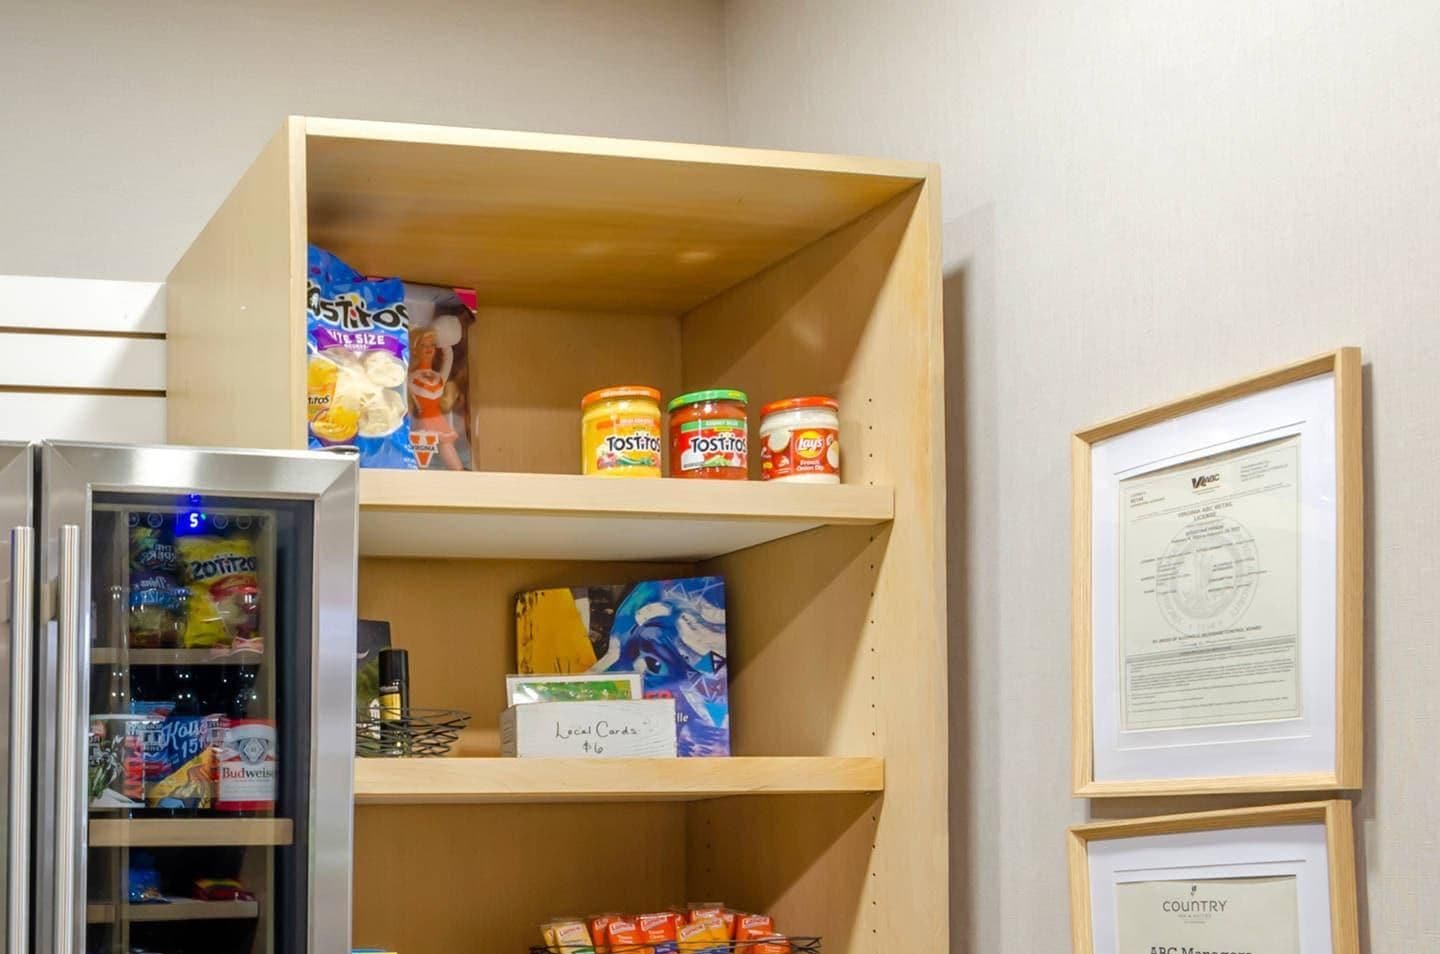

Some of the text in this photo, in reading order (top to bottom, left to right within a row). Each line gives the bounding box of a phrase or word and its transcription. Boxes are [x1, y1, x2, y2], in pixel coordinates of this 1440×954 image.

[355, 332, 386, 345] SIZE
[555, 719, 639, 740] Local Cards
[582, 742, 604, 755] $6
[1162, 900, 1228, 913] COUNTRY
